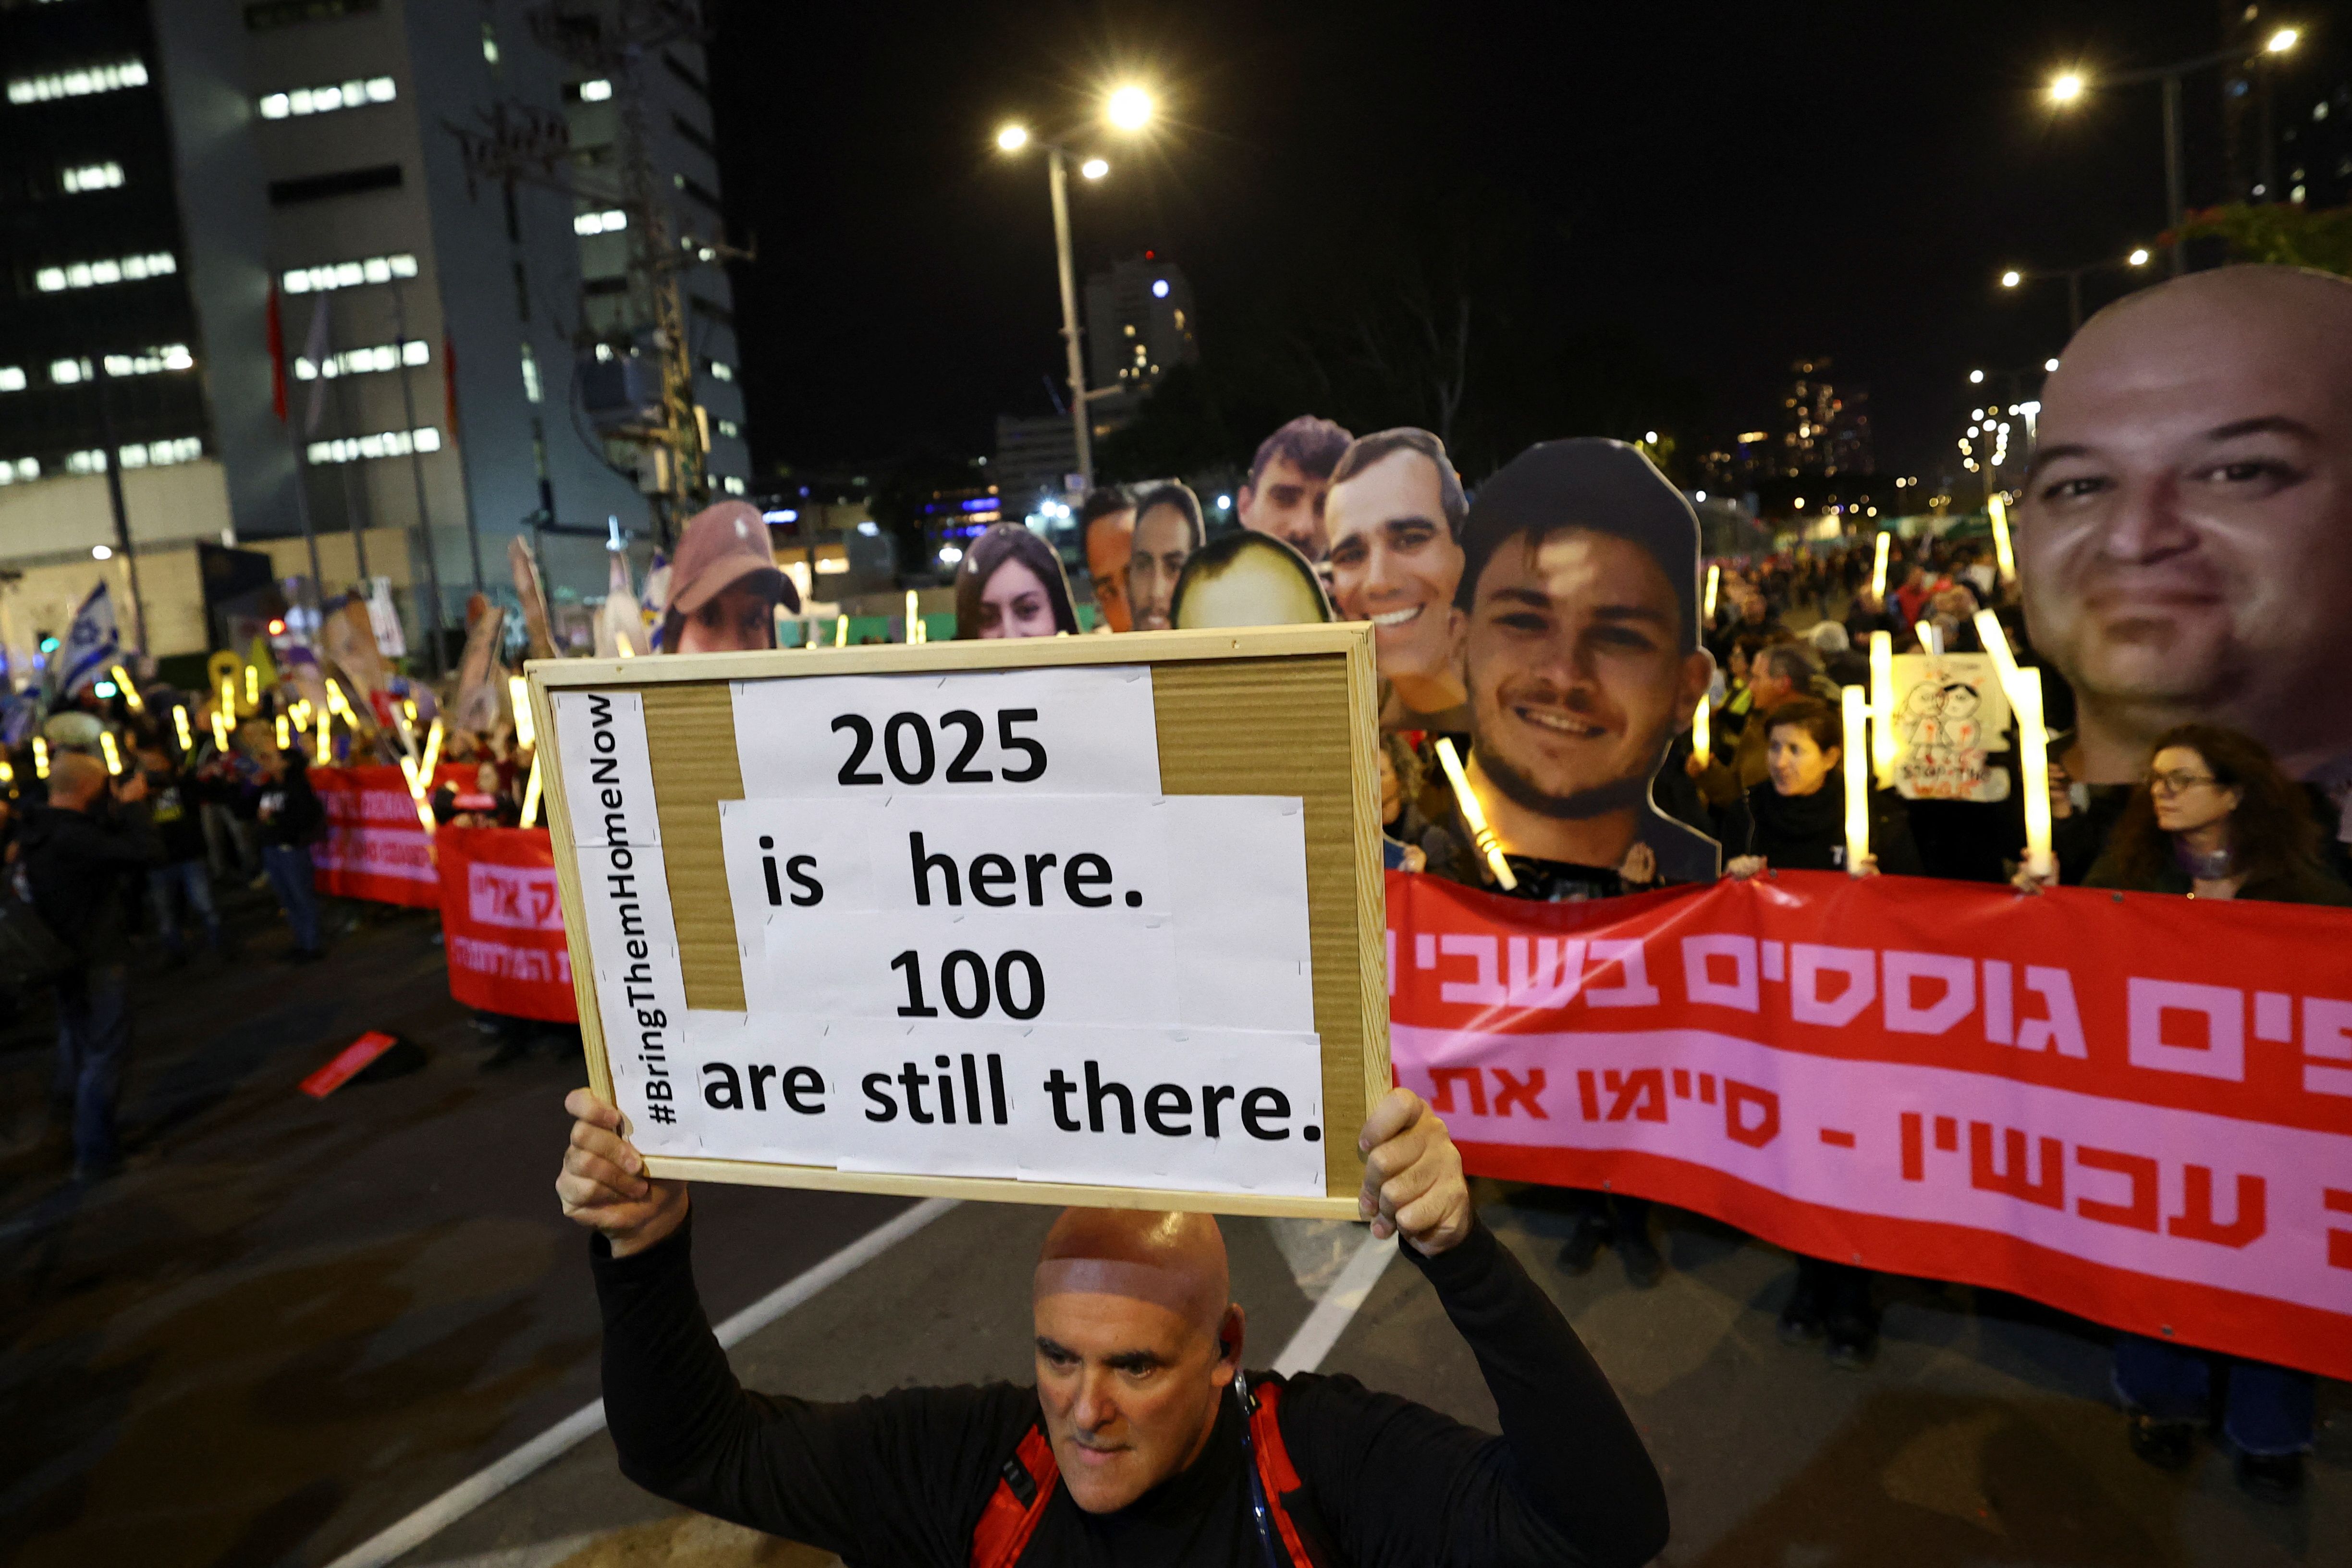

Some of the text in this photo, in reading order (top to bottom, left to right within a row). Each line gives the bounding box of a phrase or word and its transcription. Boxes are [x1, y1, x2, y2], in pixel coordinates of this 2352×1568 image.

[831, 708, 1048, 786] 2025
[588, 694, 676, 1125] #BringThemHomeNow
[759, 831, 1142, 907] is here.
[890, 949, 1045, 1021] 100
[1682, 933, 2088, 1059] גוססים
[702, 1053, 1321, 1142] are still there.
[1428, 1066, 1549, 1120] את
[1577, 1067, 1780, 1149] סיימו
[1901, 1112, 2267, 1250] עכשיו
